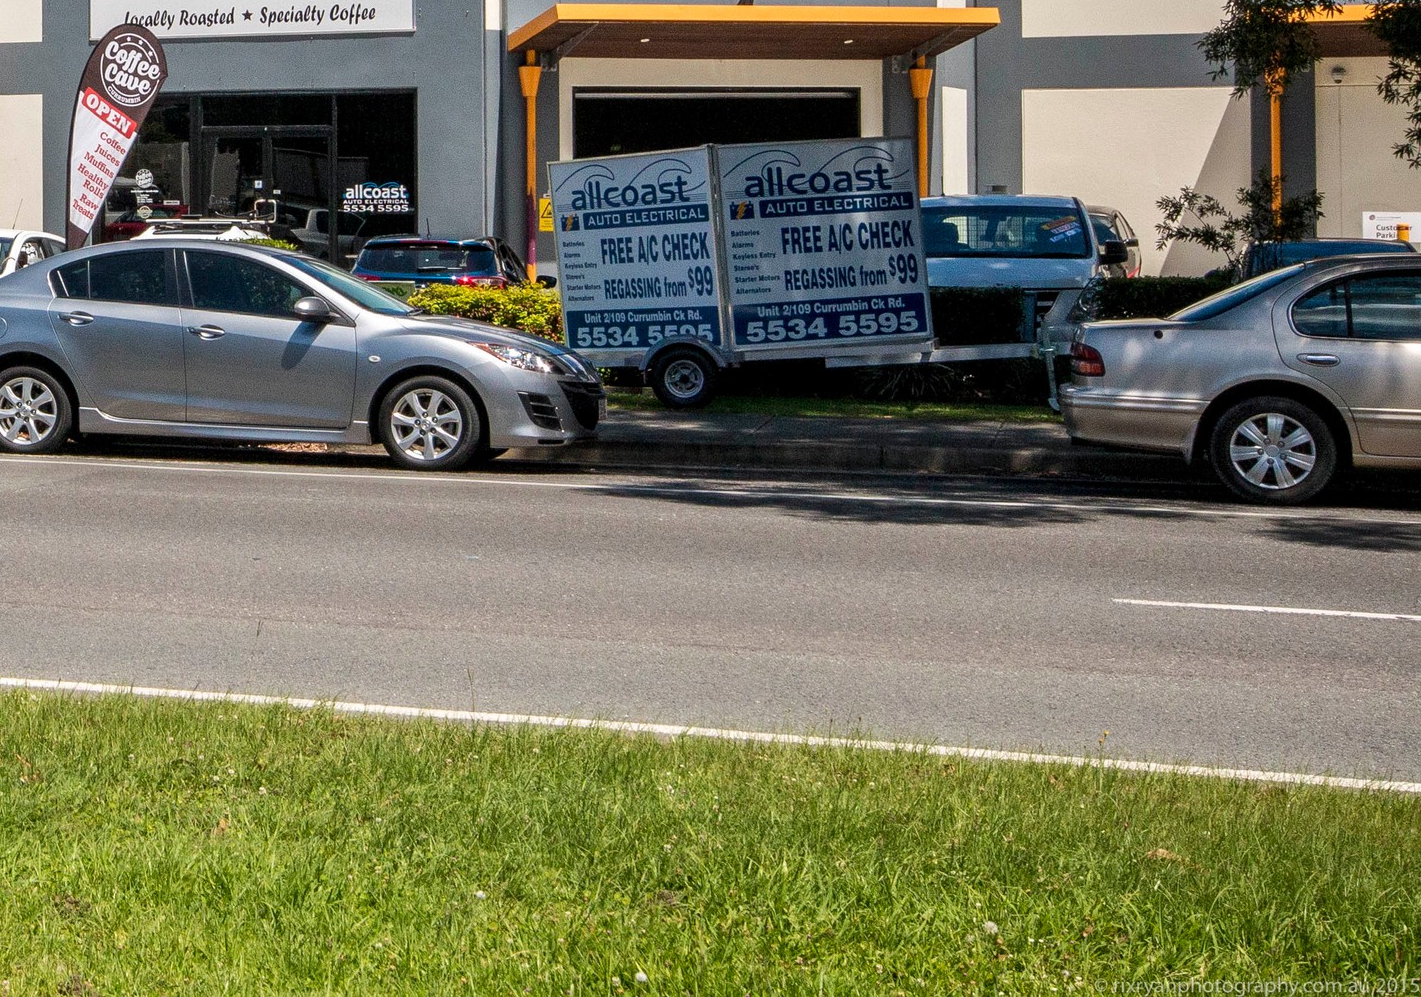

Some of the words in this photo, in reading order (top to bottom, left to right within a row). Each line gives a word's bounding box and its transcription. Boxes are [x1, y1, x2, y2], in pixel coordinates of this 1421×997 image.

[125, 10, 175, 30] Locally
[180, 7, 235, 27] Roasted
[259, 5, 325, 25] Specialty
[329, 3, 376, 25] Coffee
[105, 41, 160, 80] Coffee
[104, 63, 152, 95] Cave
[86, 93, 132, 134] OPEN
[99, 131, 126, 155] Coffee
[84, 152, 115, 179] Muffins
[94, 144, 121, 168] Juices
[77, 163, 109, 190] Healthy
[745, 163, 892, 197] allcoast
[83, 179, 105, 200] Rolls
[345, 184, 407, 199] allcoast
[571, 175, 690, 210] allcoast
[73, 199, 95, 220] Treats
[80, 193, 99, 211] Raw
[343, 204, 375, 212] 5534
[377, 204, 409, 212] 5595
[765, 202, 807, 214] AUTO
[814, 197, 909, 212] ELECTRICAL
[588, 213, 621, 226] AUTO
[626, 208, 705, 223] ELECTRICAL
[731, 229, 760, 237] Batteries
[781, 226, 823, 254] FREE
[828, 223, 854, 254] A/C
[857, 220, 915, 250] CHECK
[600, 236, 635, 265] FREE
[638, 235, 659, 265] A/C
[662, 232, 711, 262] CHECK
[733, 253, 758, 261] Keyless
[759, 252, 776, 260] Entry
[734, 264, 759, 272] Stereo's
[784, 266, 856, 291] REGASSING
[860, 265, 887, 286] from
[889, 253, 919, 284] $99
[604, 277, 662, 300] REGASSING
[664, 277, 687, 297] from
[688, 266, 713, 296] $99
[736, 287, 771, 295] Alternators
[584, 313, 602, 324] Unit
[604, 312, 626, 324] 2/109
[628, 310, 672, 322] Currumbin
[673, 310, 686, 321] Ck
[688, 310, 702, 321] Rd.
[757, 306, 780, 318] Unit
[783, 303, 811, 316] 2/109
[813, 300, 868, 313] Currumbin
[871, 298, 885, 309] Ck
[888, 297, 905, 308] Rd.
[577, 326, 639, 347] 5534
[746, 317, 828, 343] 5534
[839, 311, 919, 336] 5595
